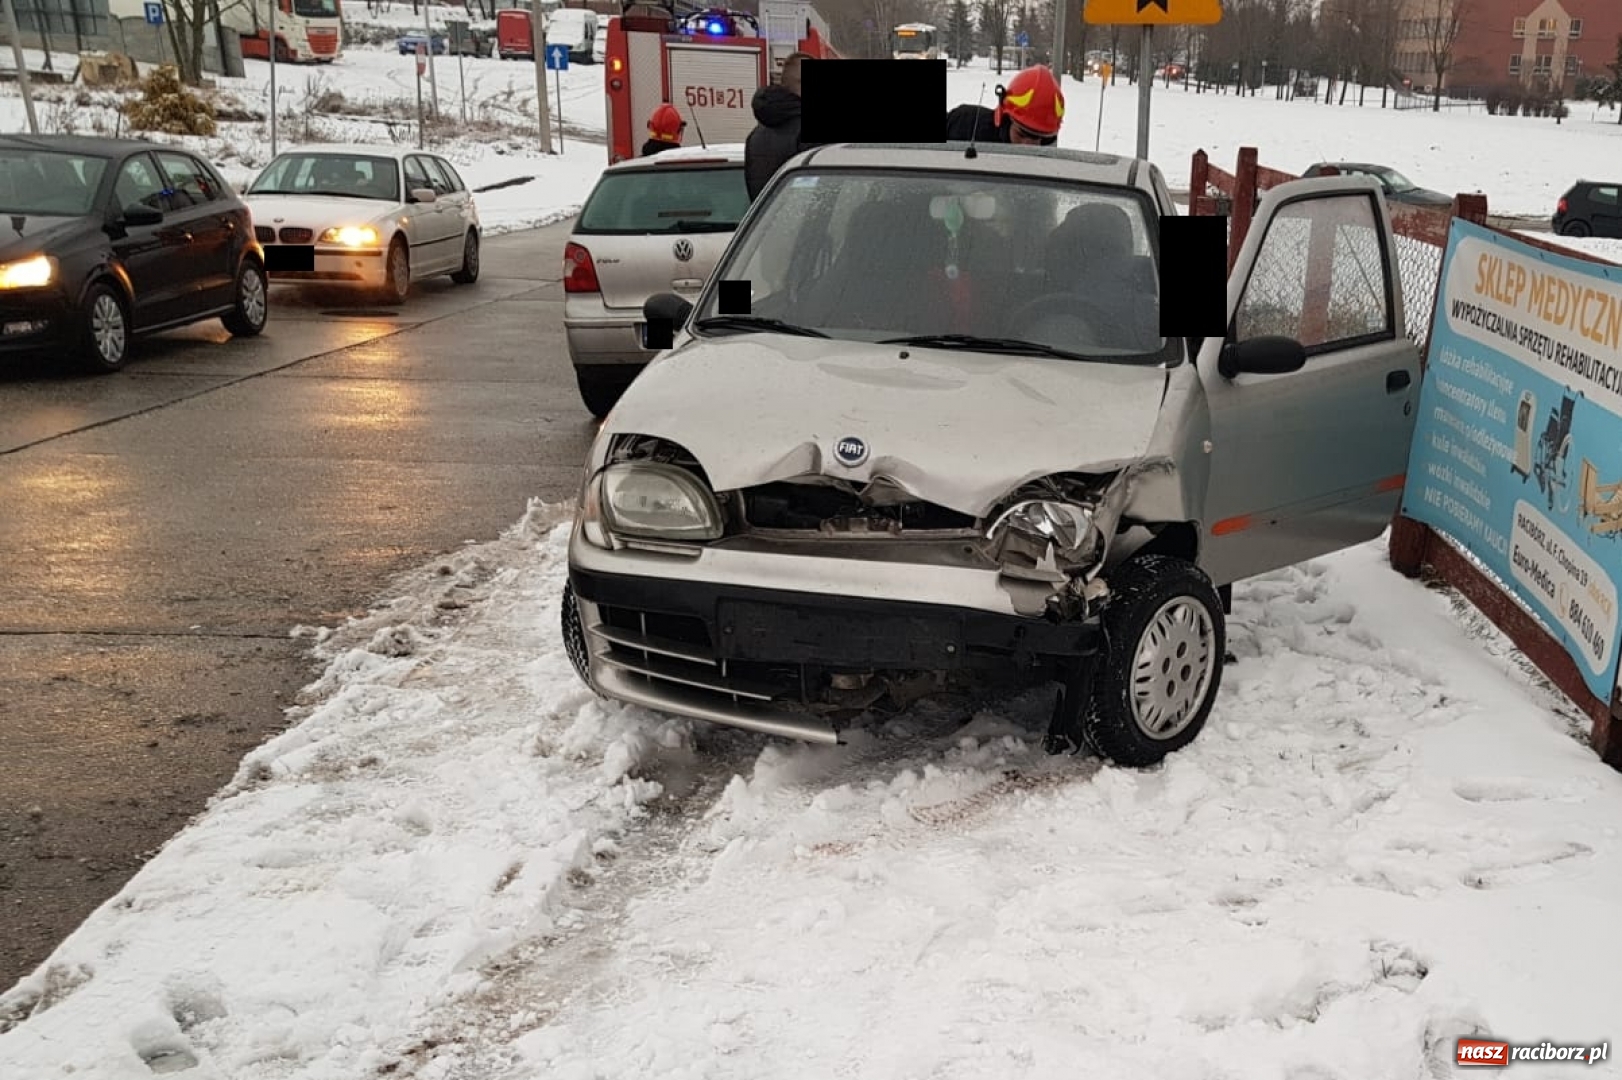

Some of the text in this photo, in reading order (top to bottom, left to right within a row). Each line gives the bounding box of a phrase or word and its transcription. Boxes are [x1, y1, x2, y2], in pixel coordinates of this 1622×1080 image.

[149, 8, 160, 23] P
[685, 86, 714, 108] 561
[727, 88, 744, 109] 21
[1474, 252, 1526, 308] SKLEP
[1452, 298, 1518, 342] WYPOŻYCZALNIA
[1518, 326, 1556, 361] SPRZĘTU
[839, 441, 864, 455] FIAT
[1423, 485, 1441, 508] NIE
[1512, 545, 1556, 600] Euro-Medica
